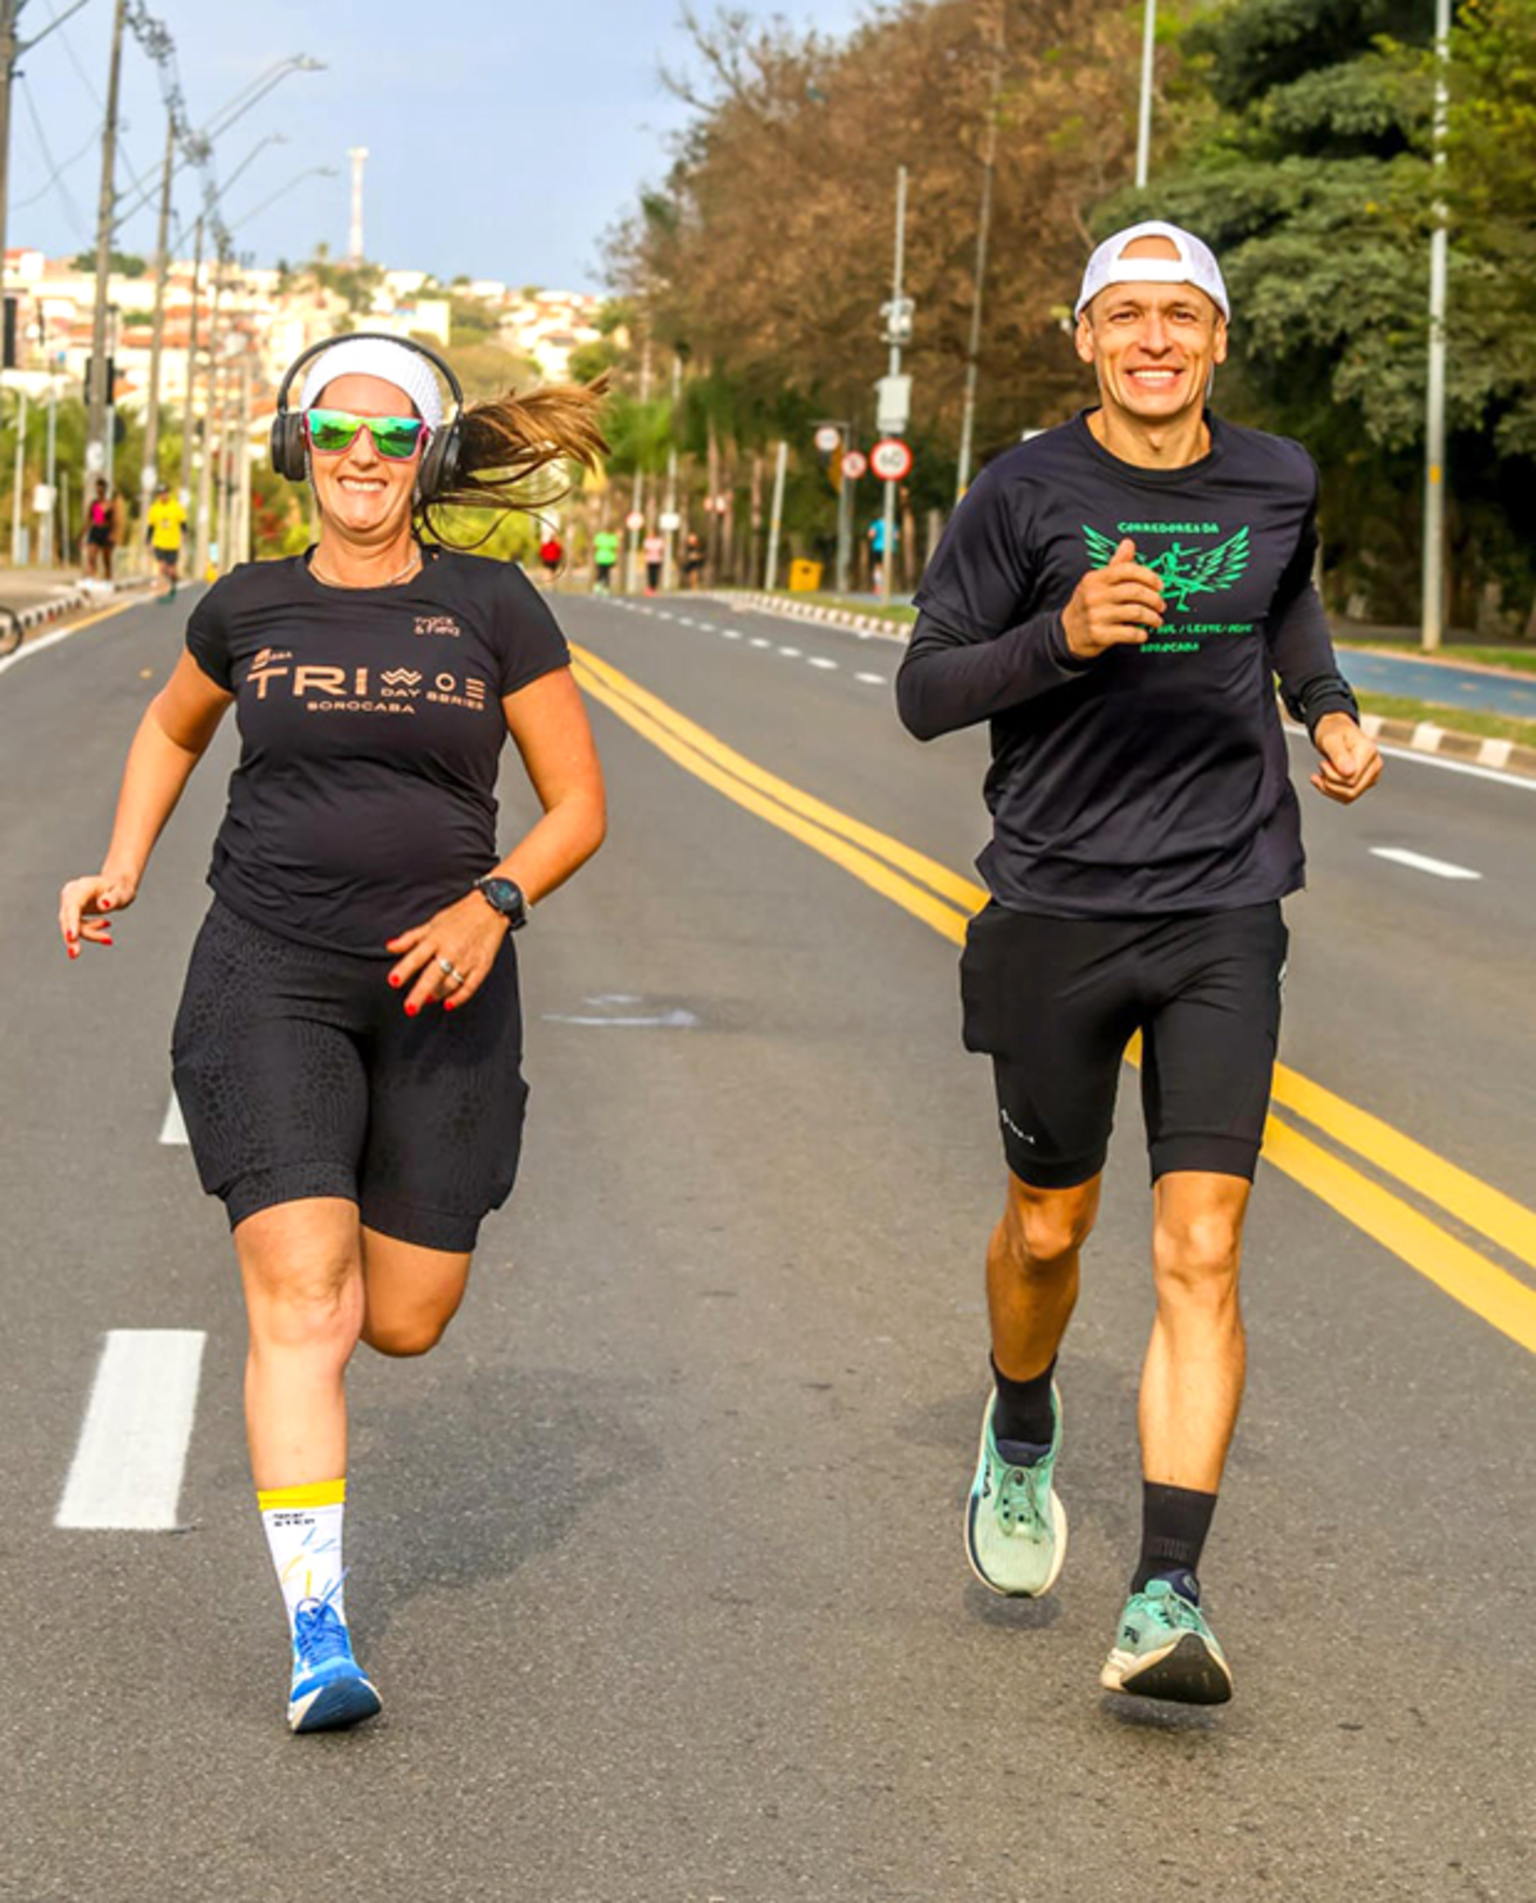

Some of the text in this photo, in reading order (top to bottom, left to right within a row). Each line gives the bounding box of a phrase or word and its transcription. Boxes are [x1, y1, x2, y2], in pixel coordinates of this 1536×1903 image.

[1201, 522, 1219, 534] DA
[246, 666, 368, 699] TRI
[306, 700, 416, 714] SOROCABA
[381, 687, 485, 711] DAY SERIES
